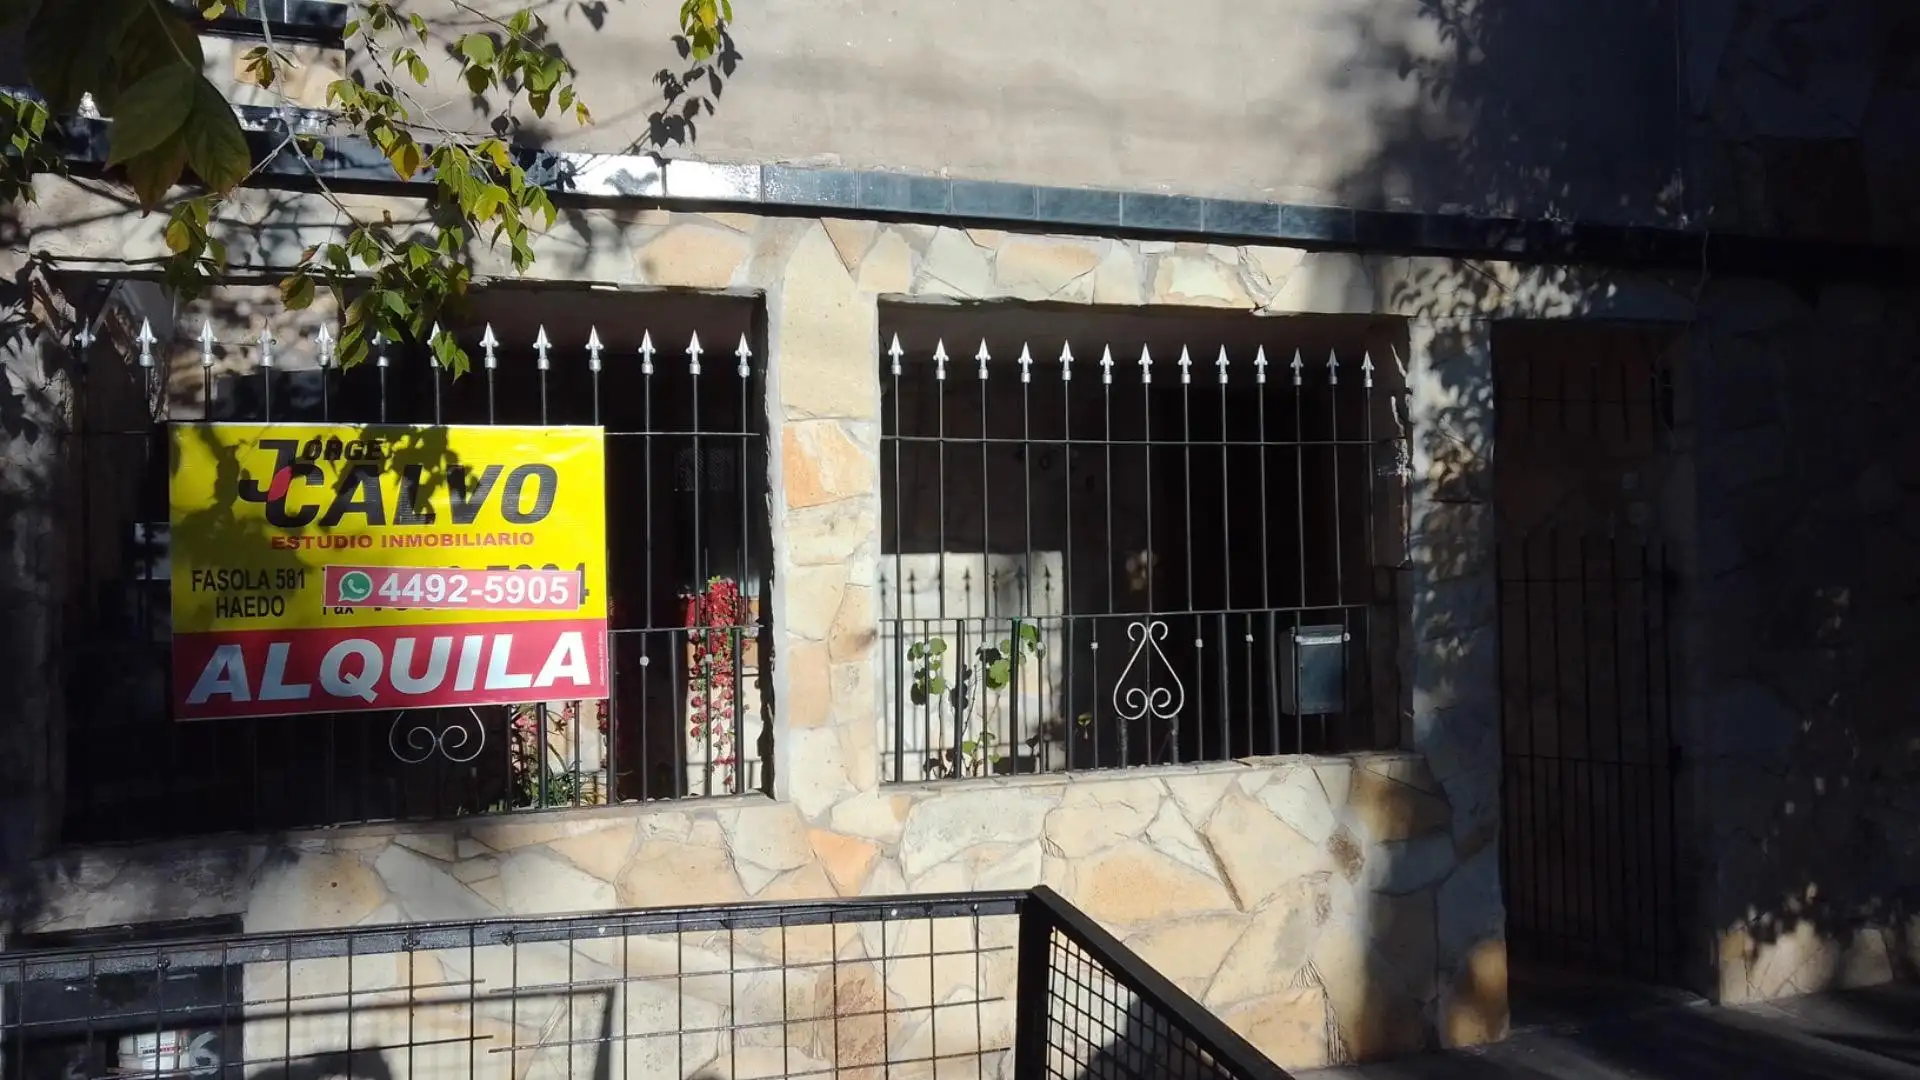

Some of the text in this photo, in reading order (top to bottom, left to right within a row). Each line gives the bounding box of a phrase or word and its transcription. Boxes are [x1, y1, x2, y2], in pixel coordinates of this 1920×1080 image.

[265, 464, 559, 528] CALVO
[271, 532, 535, 551] ESTUDIO INMOBILIARIO
[191, 568, 306, 591] FASOLA 581
[378, 572, 569, 604] 4492-5905
[216, 595, 285, 618] HAEDO
[186, 632, 591, 702] ALQUILA
